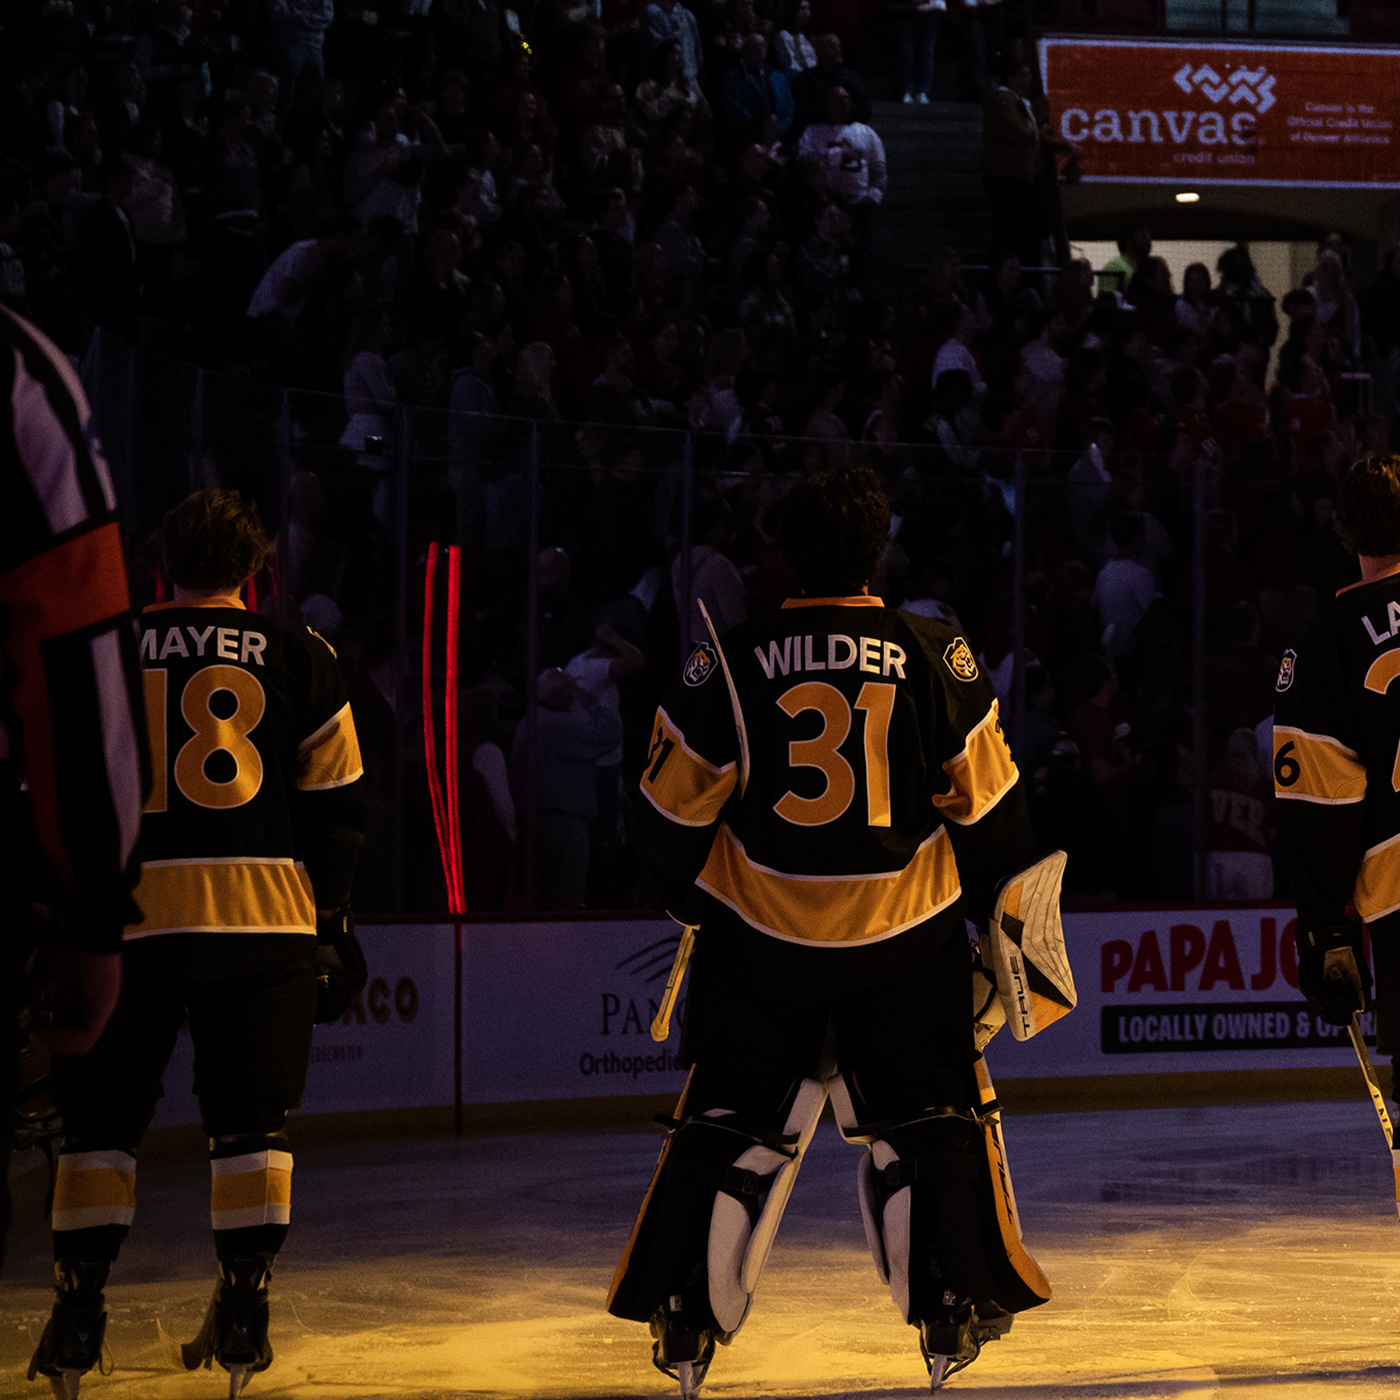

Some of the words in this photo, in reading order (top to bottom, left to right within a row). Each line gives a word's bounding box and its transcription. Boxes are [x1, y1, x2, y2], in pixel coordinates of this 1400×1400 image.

[1060, 108, 1257, 146] canvas
[140, 624, 267, 667] MAYER
[753, 633, 908, 680] WILDER
[142, 663, 267, 814] 18
[773, 680, 897, 828] 31
[1274, 741, 1300, 787] 6
[1101, 921, 1244, 992] PAPA
[1118, 1013, 1207, 1043] LOCALLY
[1211, 1009, 1290, 1041] OWNED
[1295, 1007, 1310, 1038] &
